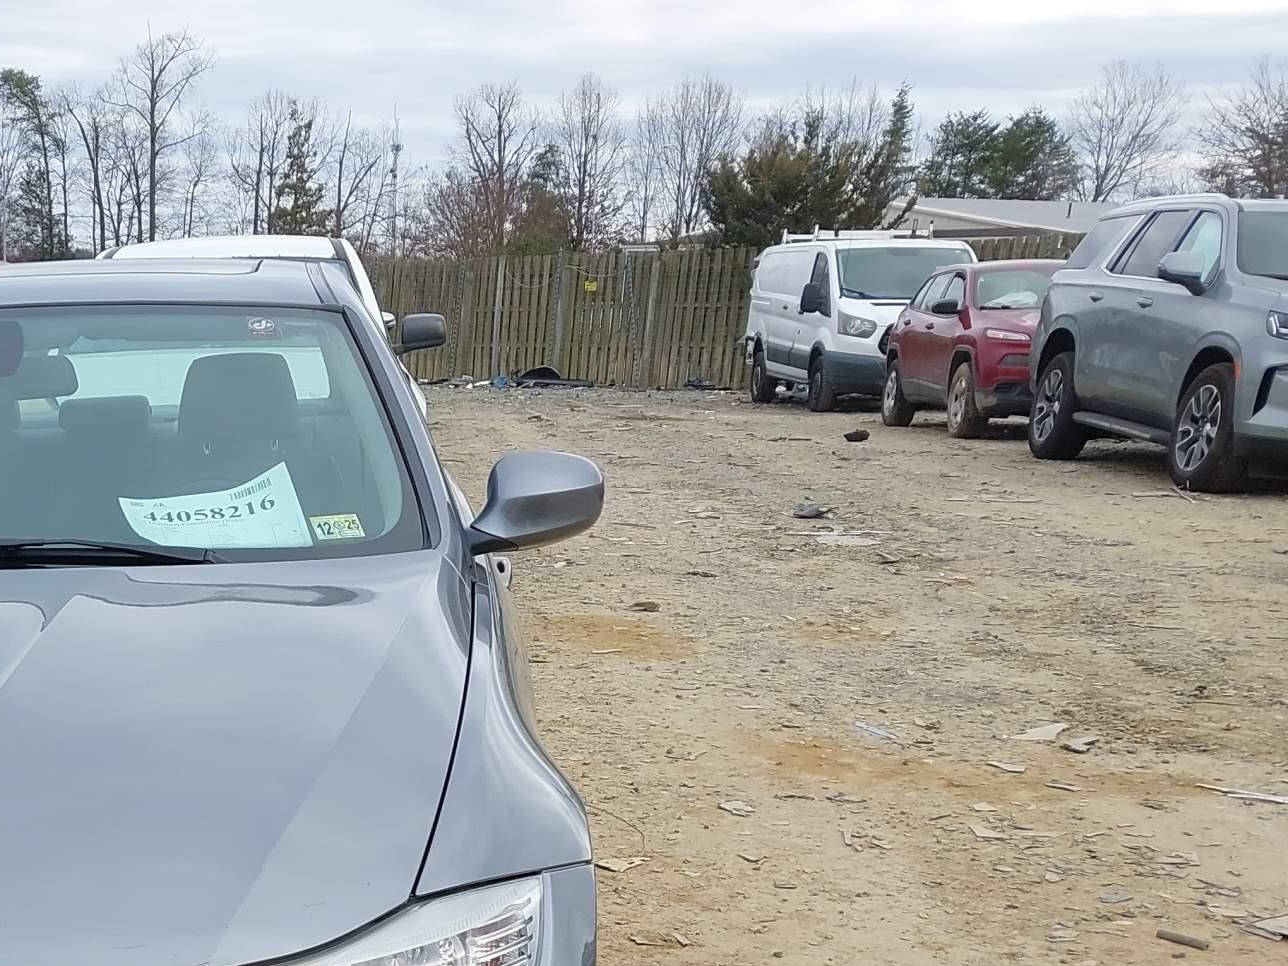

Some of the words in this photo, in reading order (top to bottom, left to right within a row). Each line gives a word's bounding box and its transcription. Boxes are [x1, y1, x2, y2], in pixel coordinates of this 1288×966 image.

[143, 492, 275, 522] 44058216
[316, 521, 334, 536] 12
[344, 518, 360, 531] 25
